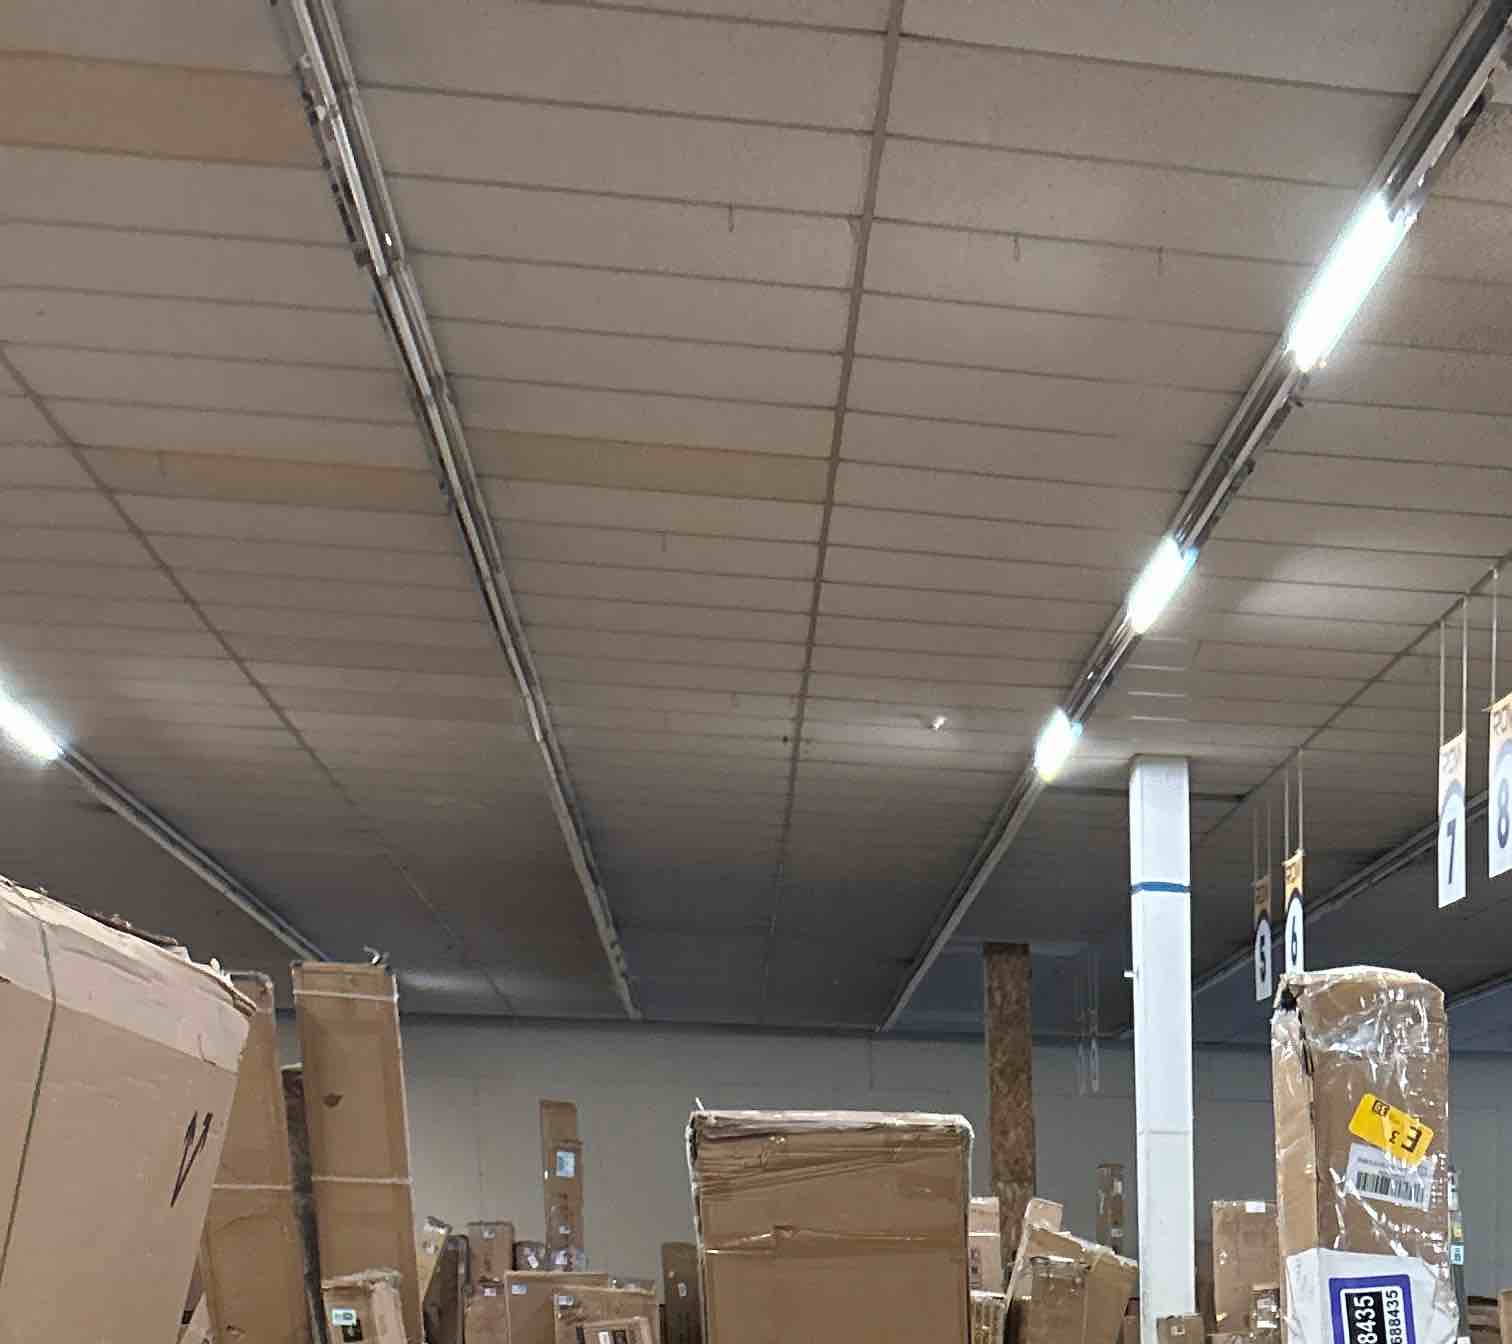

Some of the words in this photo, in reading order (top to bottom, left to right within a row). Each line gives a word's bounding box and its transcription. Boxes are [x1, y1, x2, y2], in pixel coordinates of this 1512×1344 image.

[1496, 778, 1511, 849] 8
[1445, 817, 1458, 885] 7
[1258, 933, 1267, 983] 5
[1290, 915, 1298, 965] 6
[1354, 1295, 1378, 1344] 8435
